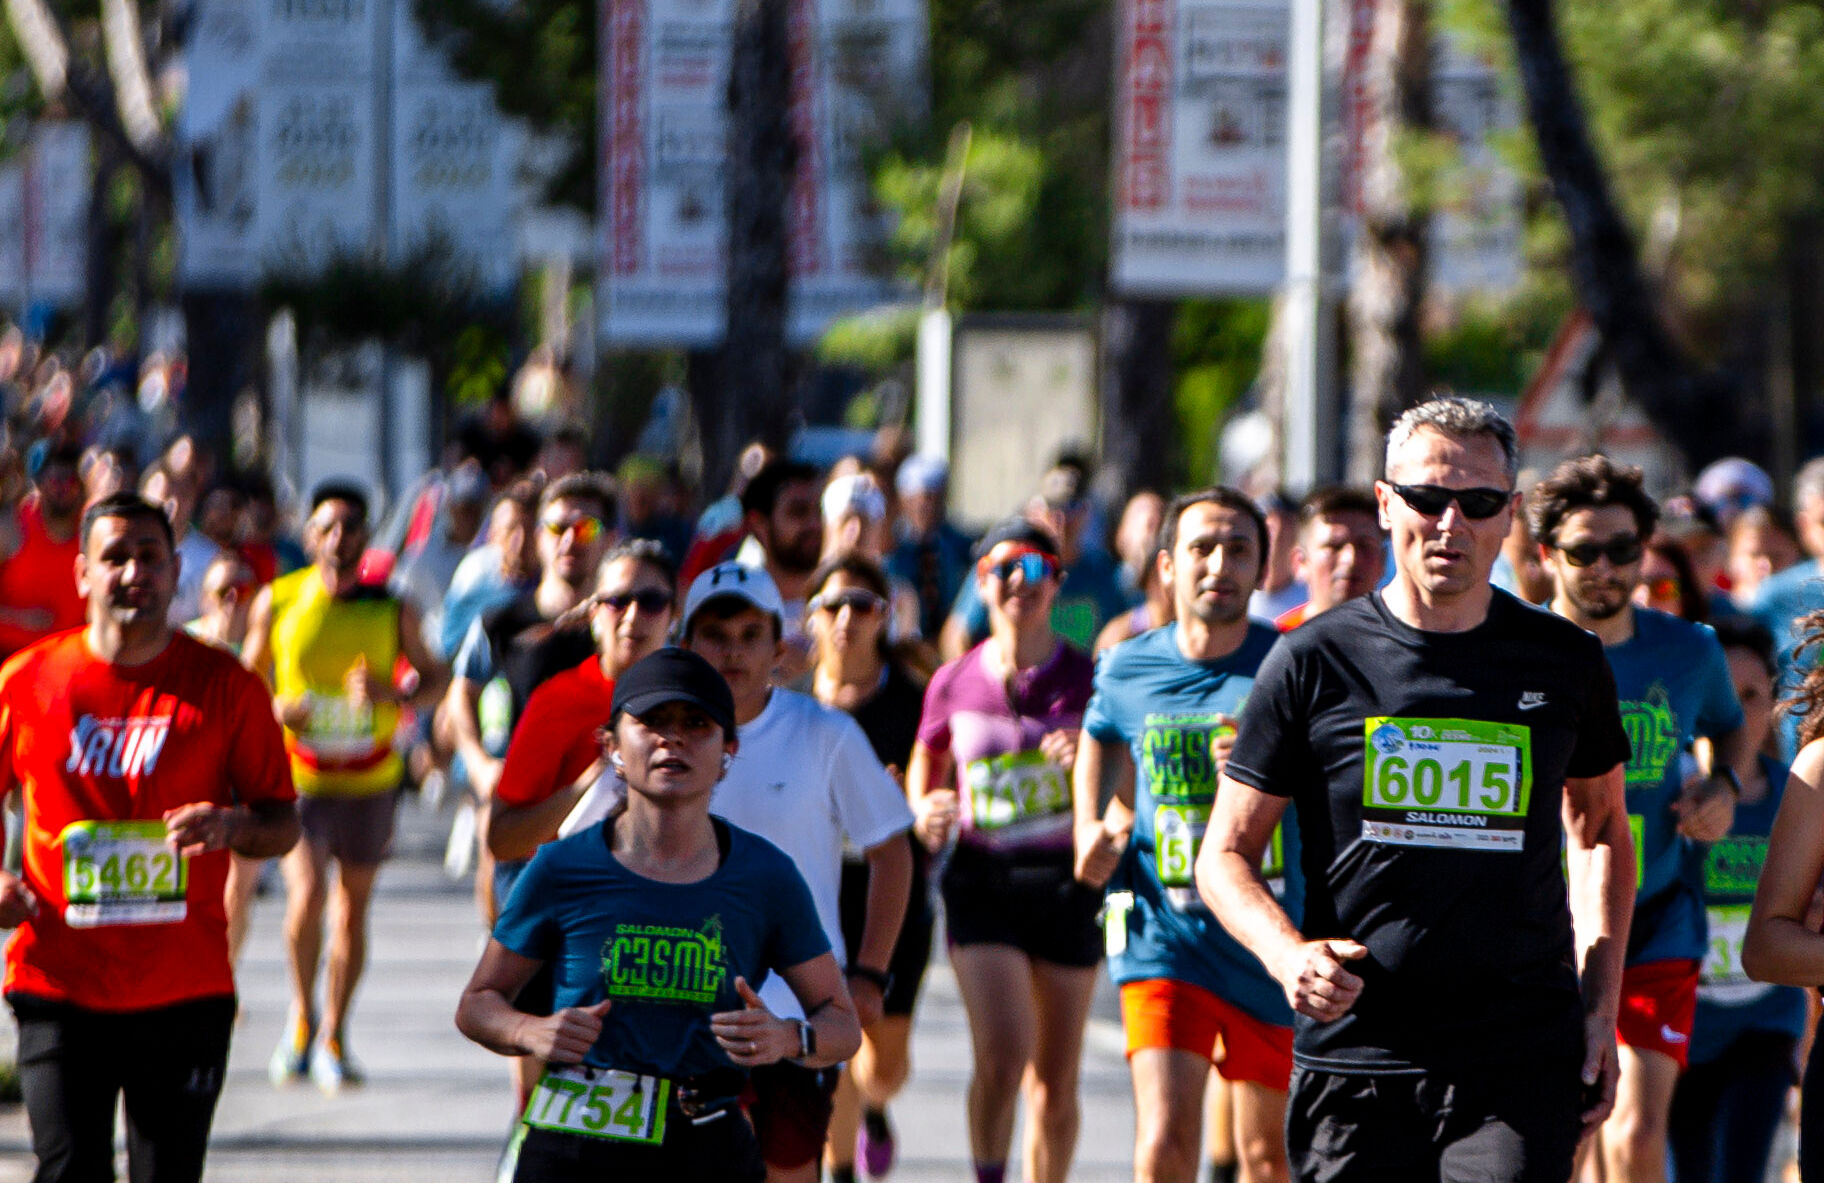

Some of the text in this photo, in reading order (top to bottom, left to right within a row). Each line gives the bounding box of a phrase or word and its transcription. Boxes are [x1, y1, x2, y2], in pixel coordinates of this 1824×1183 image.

[1378, 756, 1510, 809] 6015
[1405, 811, 1488, 827] SALOMON
[76, 853, 174, 891] 5462
[615, 923, 694, 938] SALOMON
